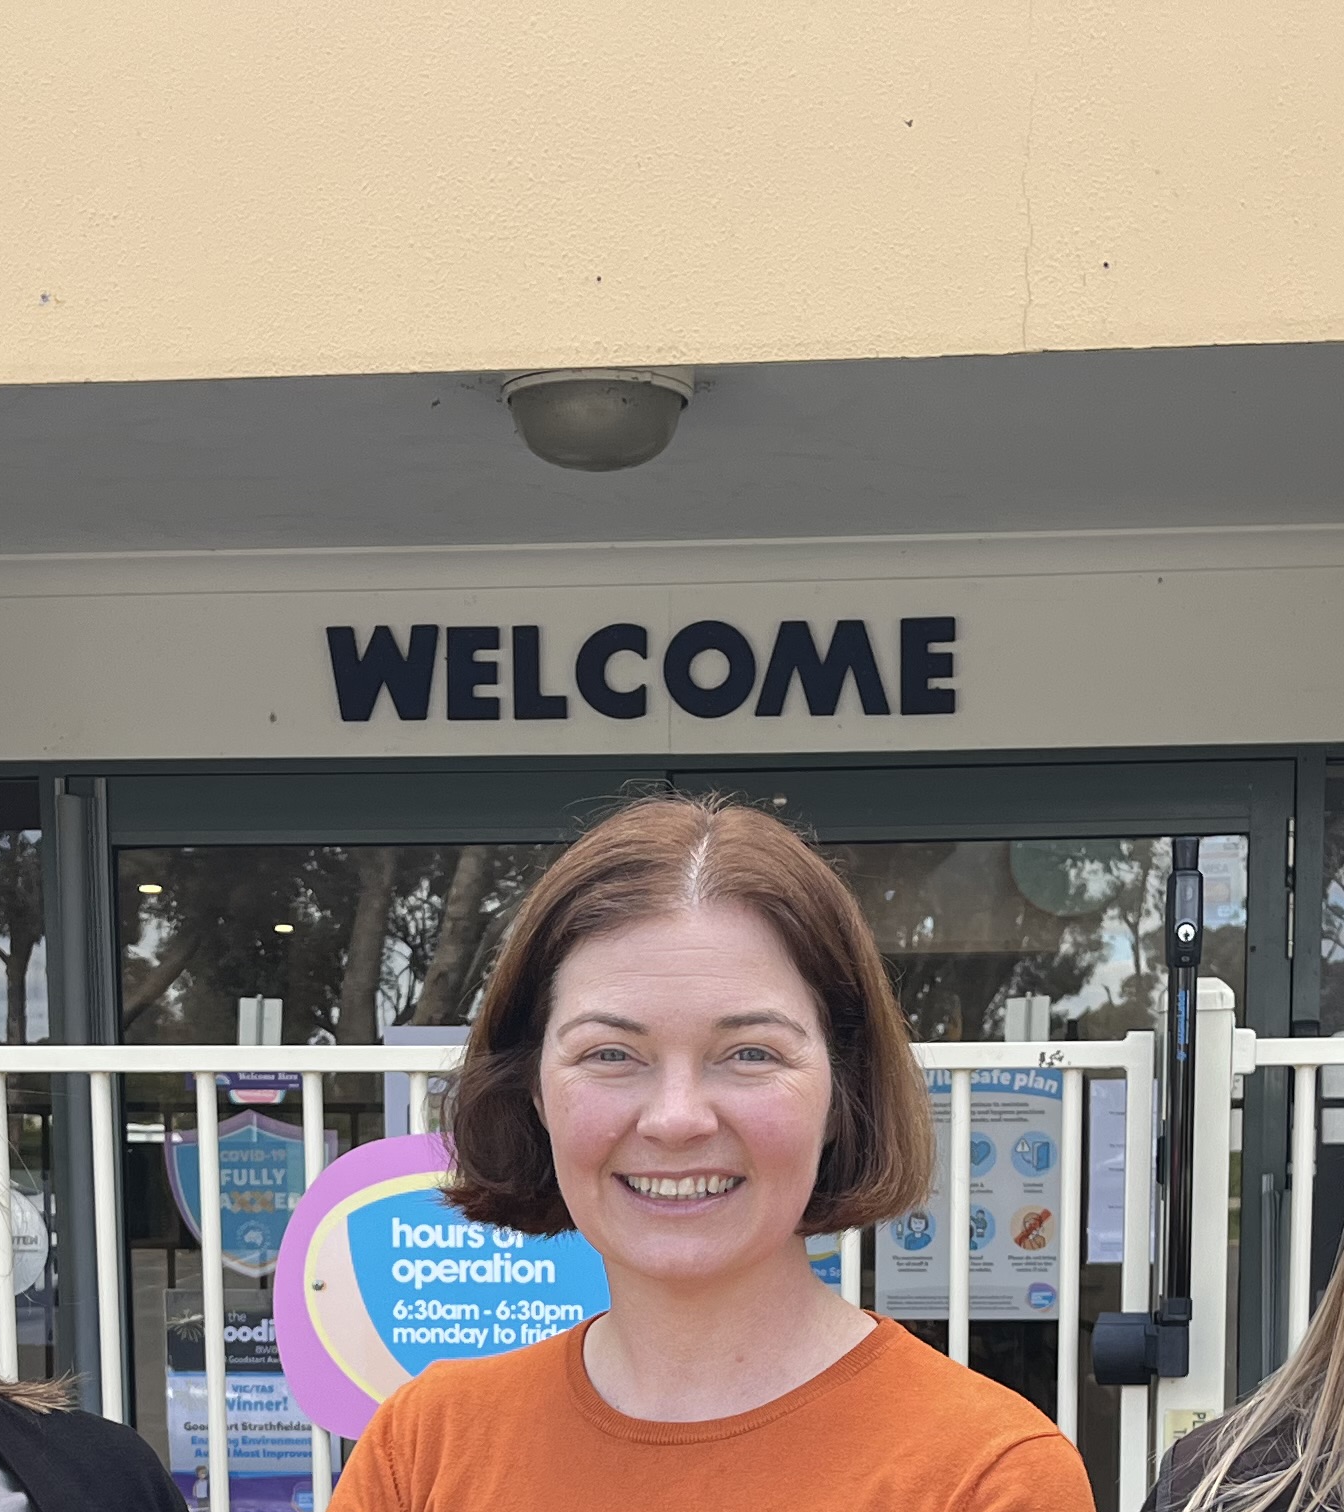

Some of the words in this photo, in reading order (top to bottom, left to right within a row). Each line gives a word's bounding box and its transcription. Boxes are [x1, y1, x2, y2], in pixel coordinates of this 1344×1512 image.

[325, 615, 957, 722] WELCOME
[1013, 1069, 1059, 1095] plan
[220, 1149, 287, 1163] COVID-19
[220, 1167, 288, 1187] FULLY
[391, 1216, 485, 1249] hours
[391, 1252, 556, 1290] operation
[228, 1310, 247, 1323] the
[392, 1299, 480, 1321] 6:30am
[495, 1300, 584, 1325] 6:30pm
[223, 1318, 276, 1343] oodi
[392, 1323, 489, 1349] monday
[493, 1324, 516, 1345] to
[231, 1384, 275, 1394] VIC/TAS
[241, 1421, 312, 1432] Strathfieldsa
[241, 1435, 312, 1446] Environment
[233, 1450, 261, 1458] Most
